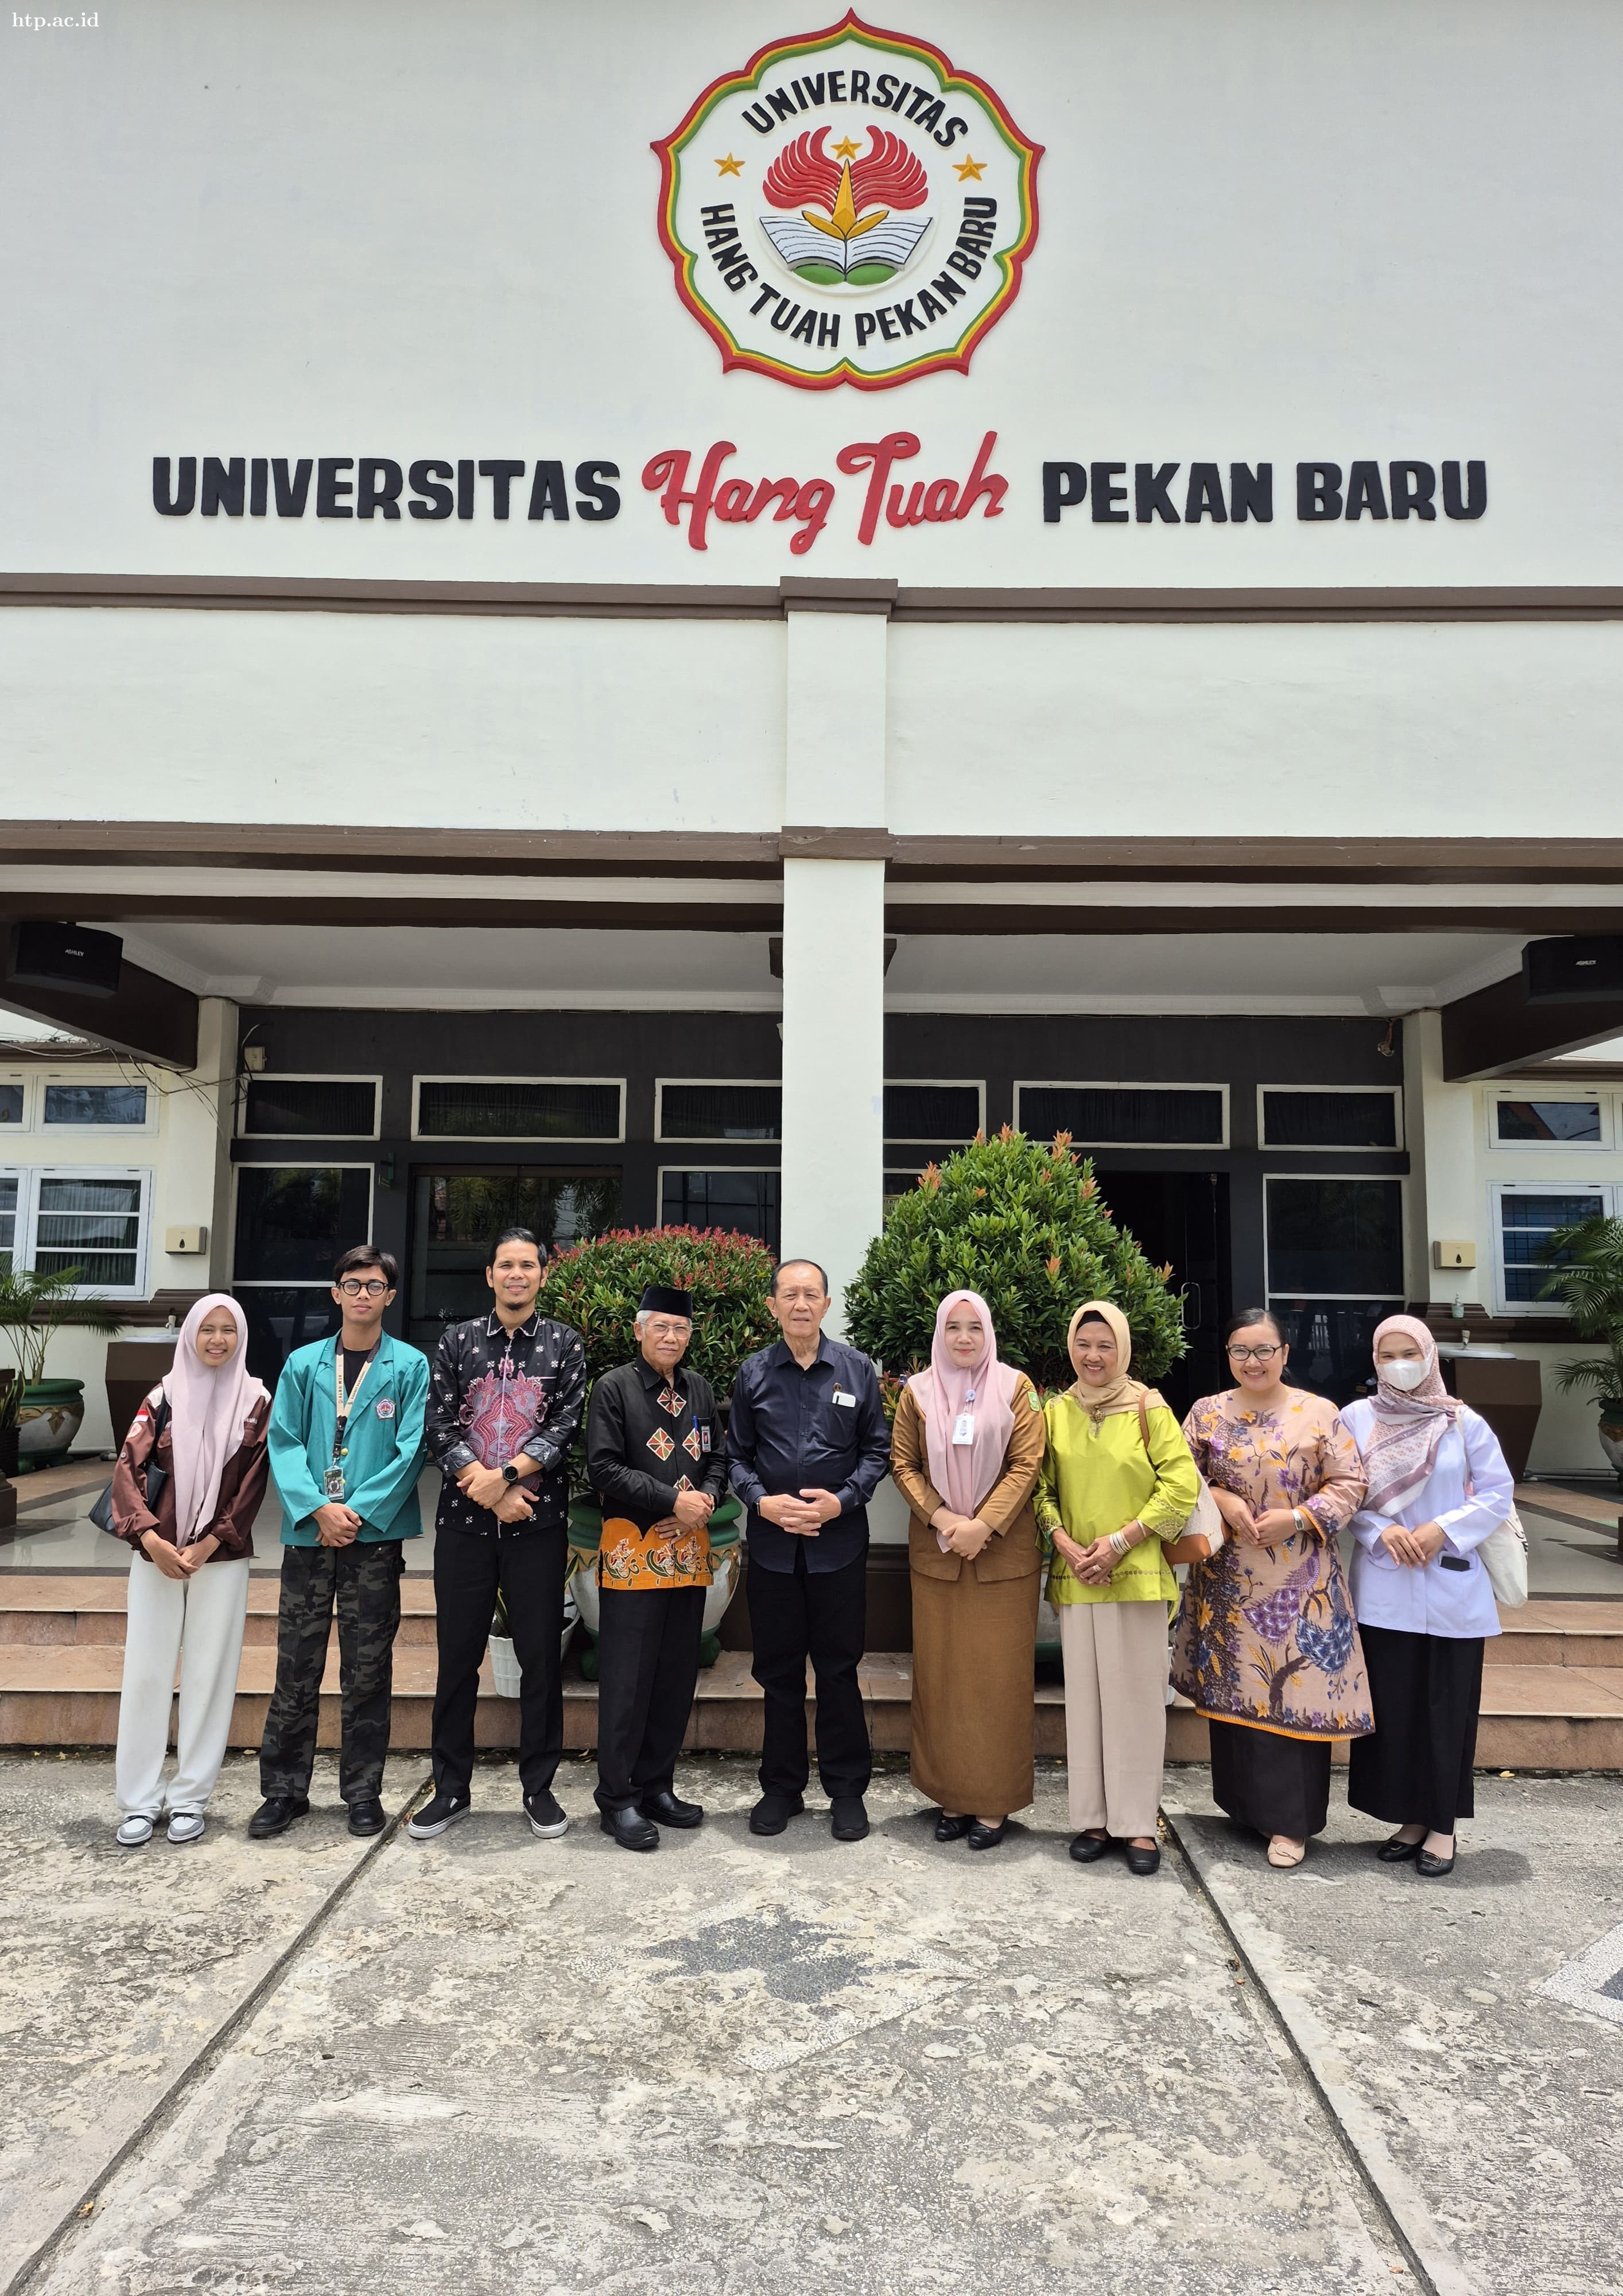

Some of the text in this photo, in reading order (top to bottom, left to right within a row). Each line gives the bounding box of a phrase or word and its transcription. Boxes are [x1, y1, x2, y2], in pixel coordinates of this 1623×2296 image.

[741, 69, 969, 148] UNIVERSITAS
[700, 197, 997, 348] HANG TUAH PEKAN BARU
[152, 431, 1487, 555] UNIVERSITAS Hang Tuah PEKAN BARU
[64, 949, 85, 957] ASHLEY
